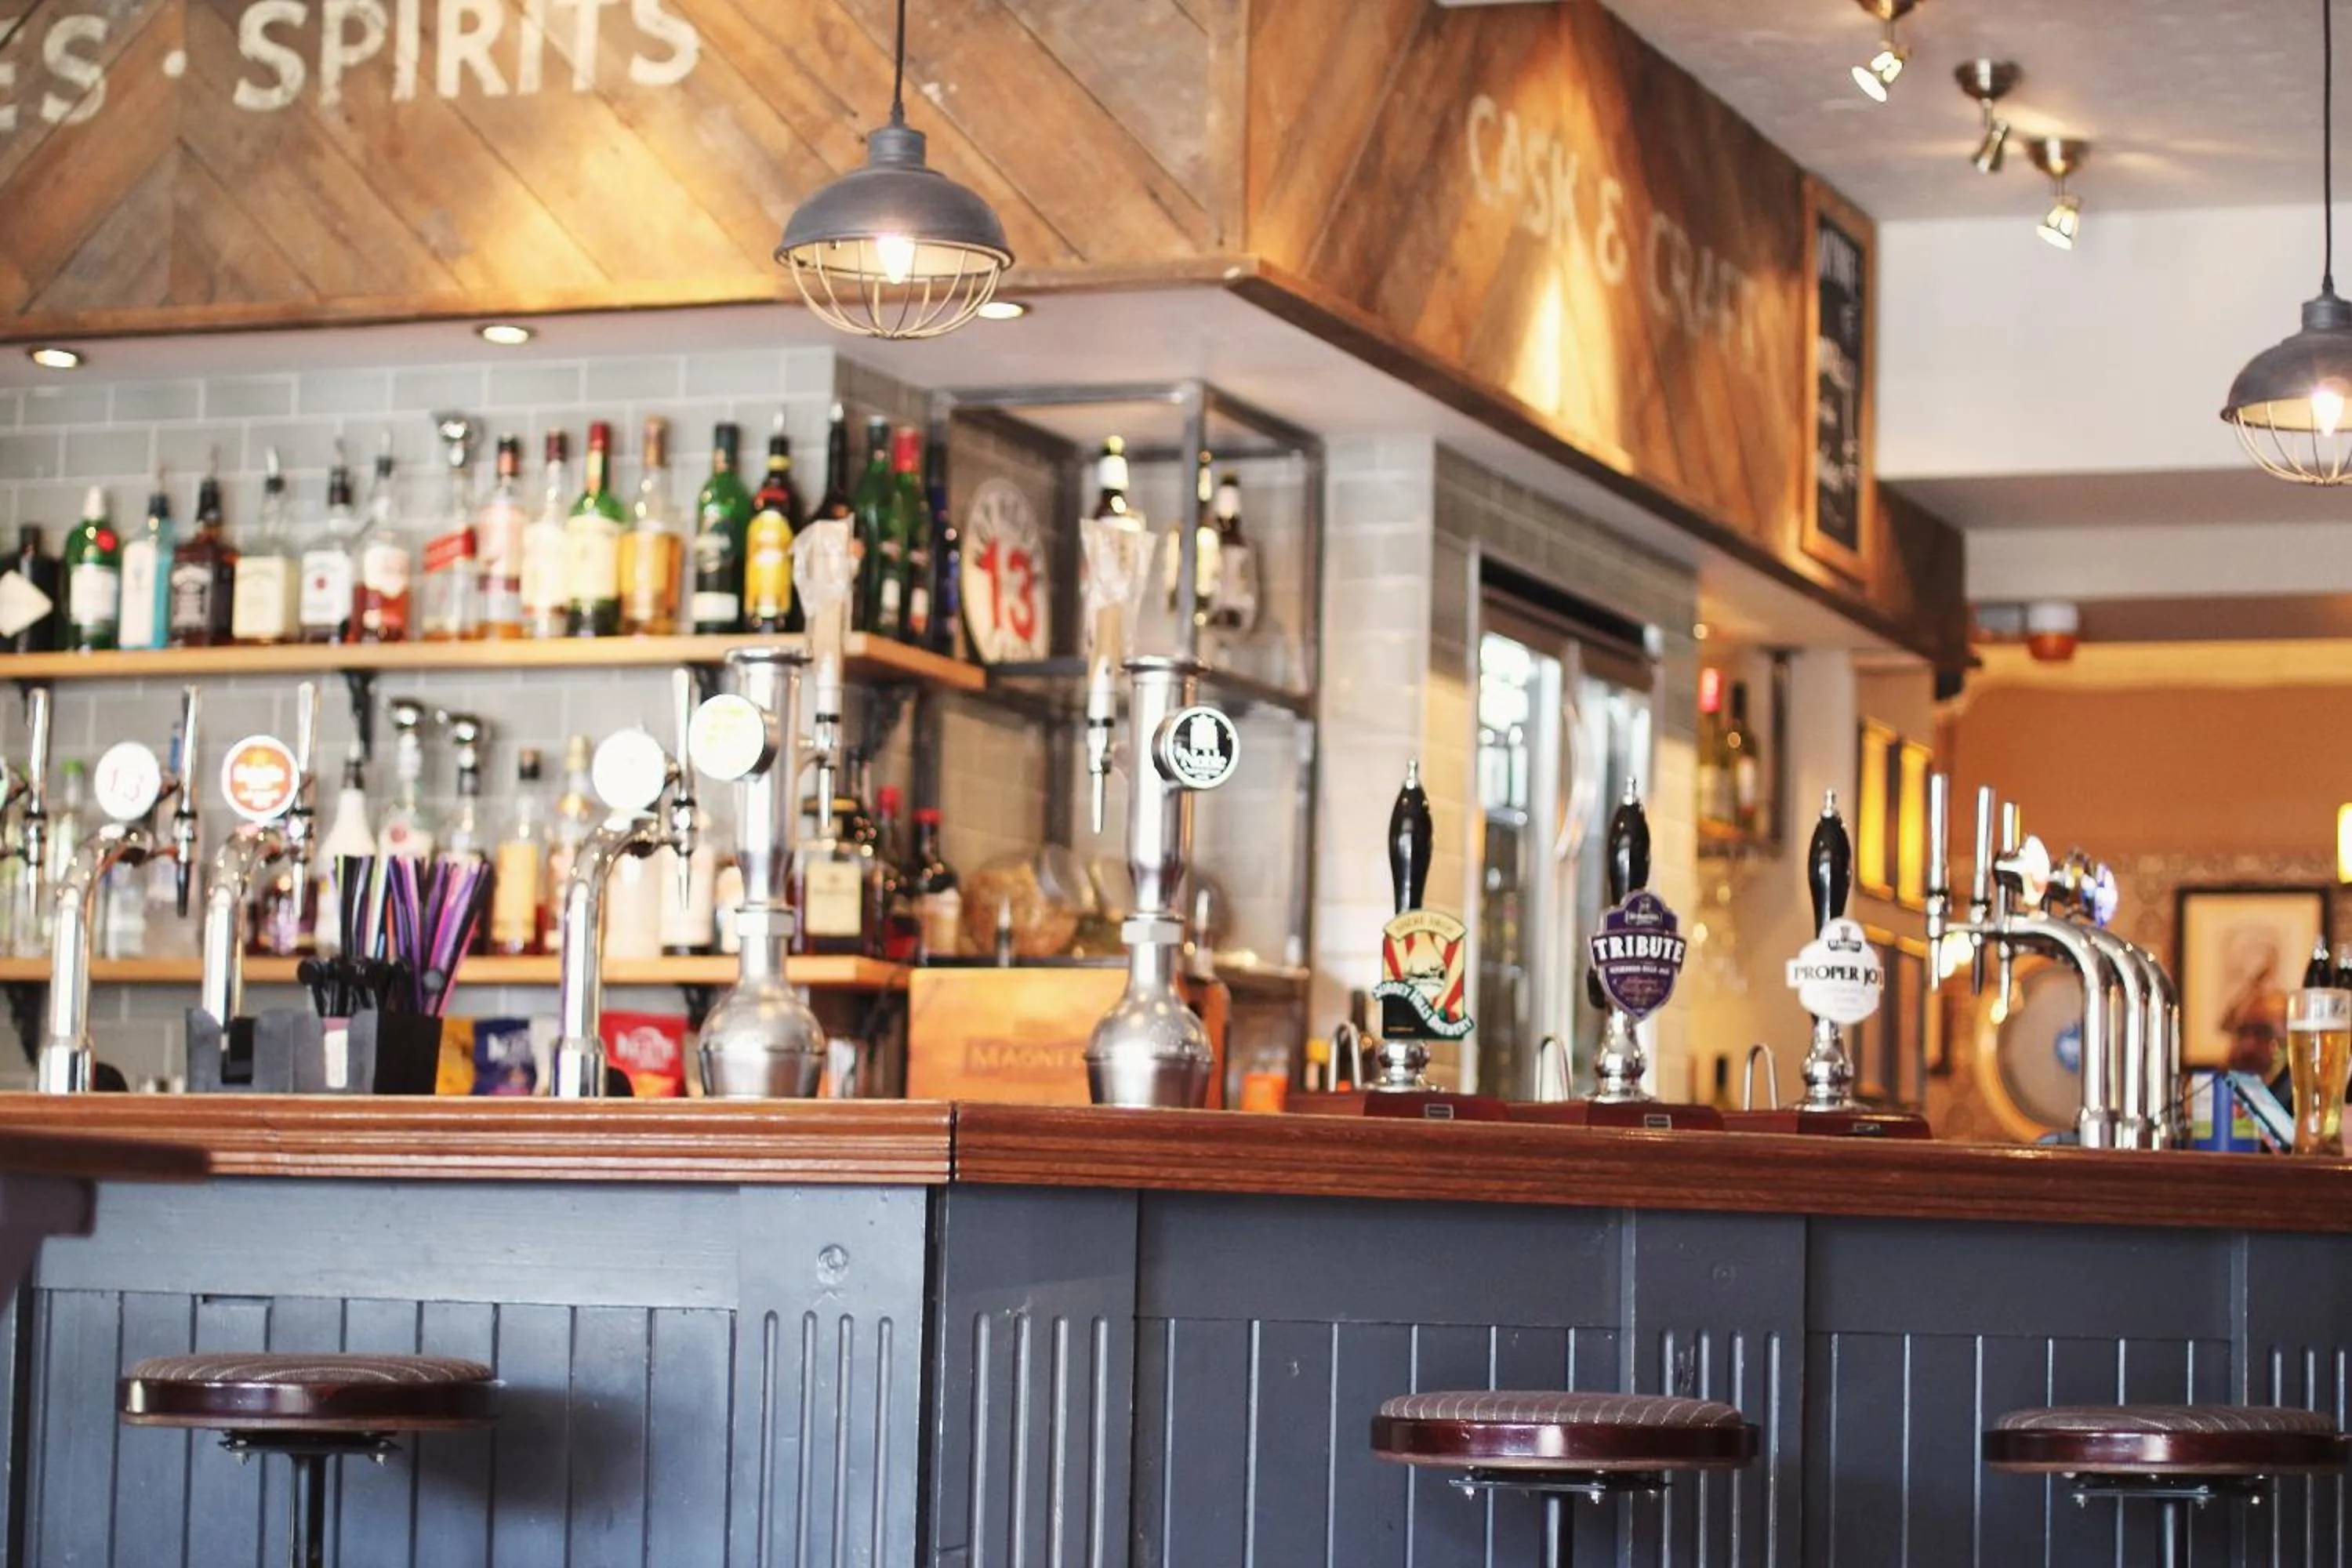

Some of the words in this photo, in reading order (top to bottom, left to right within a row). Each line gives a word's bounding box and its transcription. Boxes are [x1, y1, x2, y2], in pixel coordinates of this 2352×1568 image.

[233, 0, 702, 111] SPIRITS
[1467, 93, 1579, 255] CASK
[1596, 178, 1629, 286] &
[1592, 935, 1685, 963] TRIBUTE
[1794, 965, 1859, 981] PROPER
